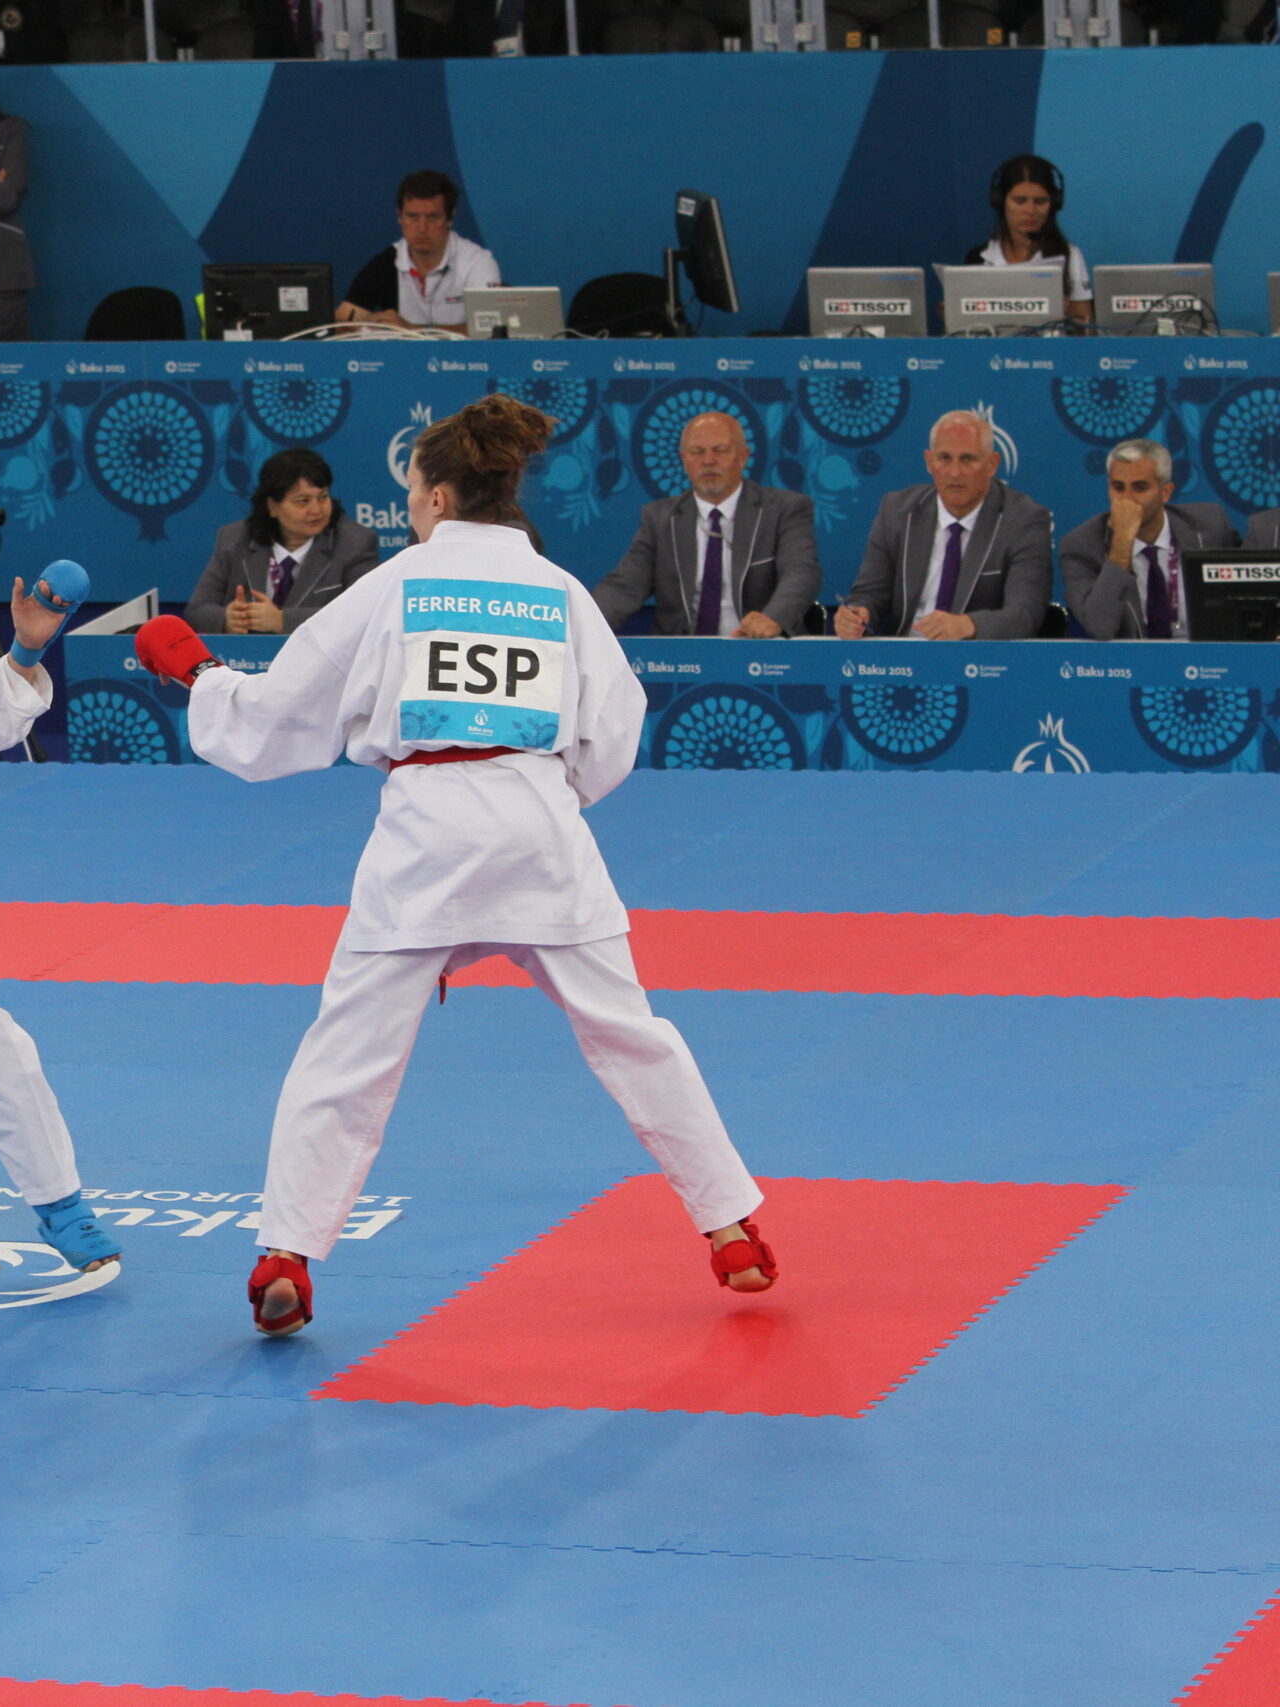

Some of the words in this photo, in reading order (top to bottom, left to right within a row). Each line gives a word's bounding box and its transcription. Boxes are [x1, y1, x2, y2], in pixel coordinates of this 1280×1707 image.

[852, 302, 908, 312] TISSOT
[989, 301, 1044, 311] TISSOT
[80, 363, 103, 373] Baku
[258, 361, 282, 372] Baku
[442, 361, 465, 371] Baku
[628, 360, 652, 370] Baku
[813, 359, 838, 370] Baku
[1004, 359, 1029, 369] Baku
[1199, 358, 1223, 368] Baku
[356, 502, 412, 529] Bak
[407, 596, 482, 614] FERRER
[487, 599, 564, 623] GARCIA
[228, 659, 256, 670] Baku
[258, 661, 271, 670] 20
[427, 640, 540, 698] ESP
[648, 661, 675, 673] Baku
[678, 664, 701, 674] 2015
[858, 664, 886, 675] Baku
[889, 667, 913, 677] 2015
[1077, 666, 1104, 677] Baku
[1108, 668, 1132, 678] 2015
[357, 1195, 412, 1207] 1S
